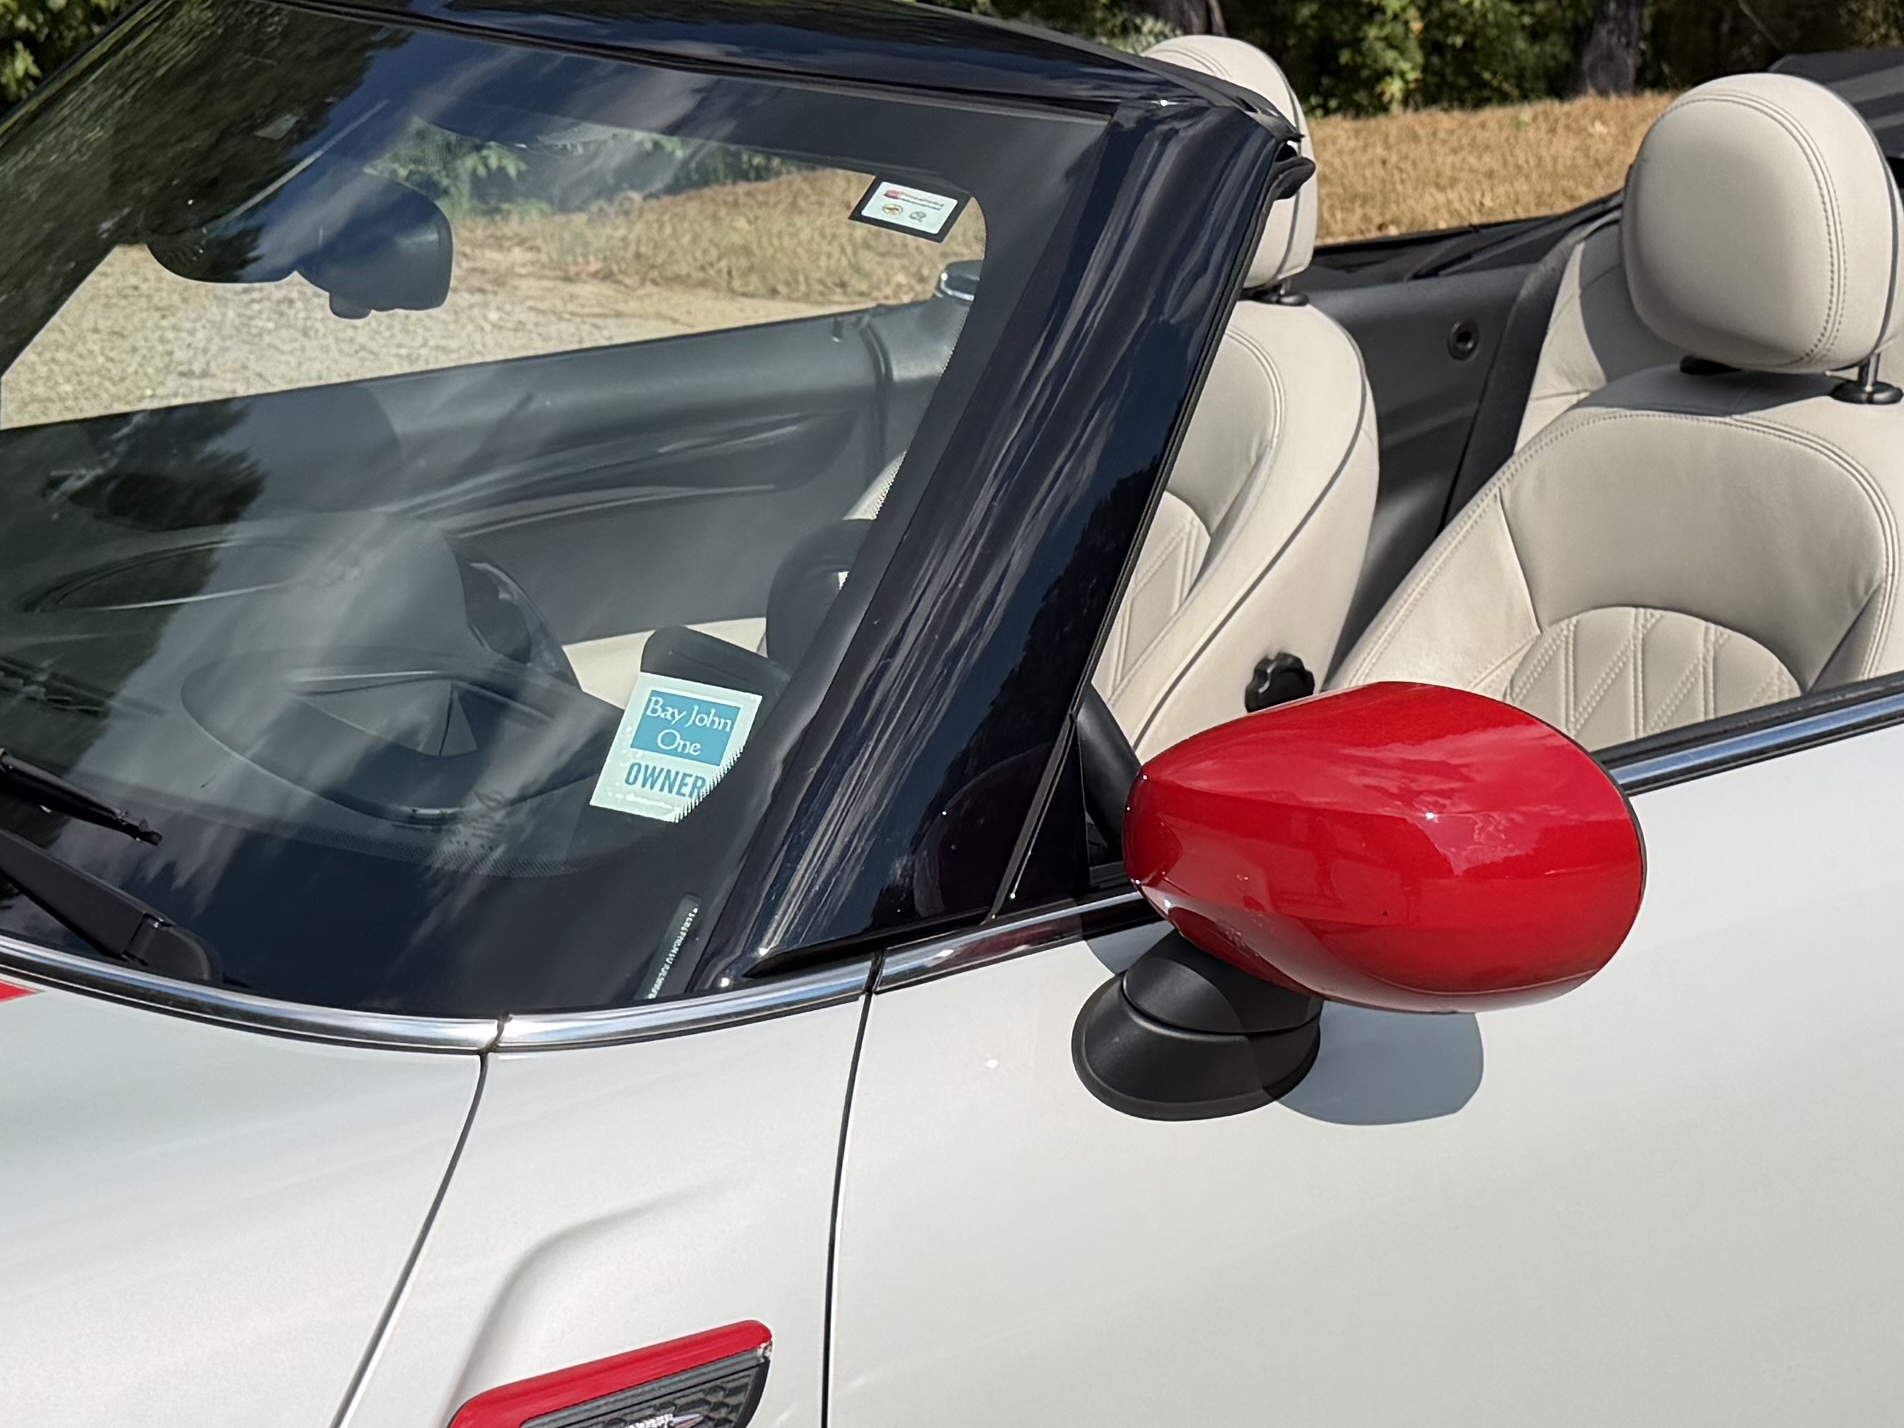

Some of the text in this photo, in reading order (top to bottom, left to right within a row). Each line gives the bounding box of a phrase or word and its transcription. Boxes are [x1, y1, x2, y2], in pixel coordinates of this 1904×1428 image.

[646, 696, 733, 733] Bay John
[657, 729, 702, 756] One
[624, 762, 707, 800] OWNER
